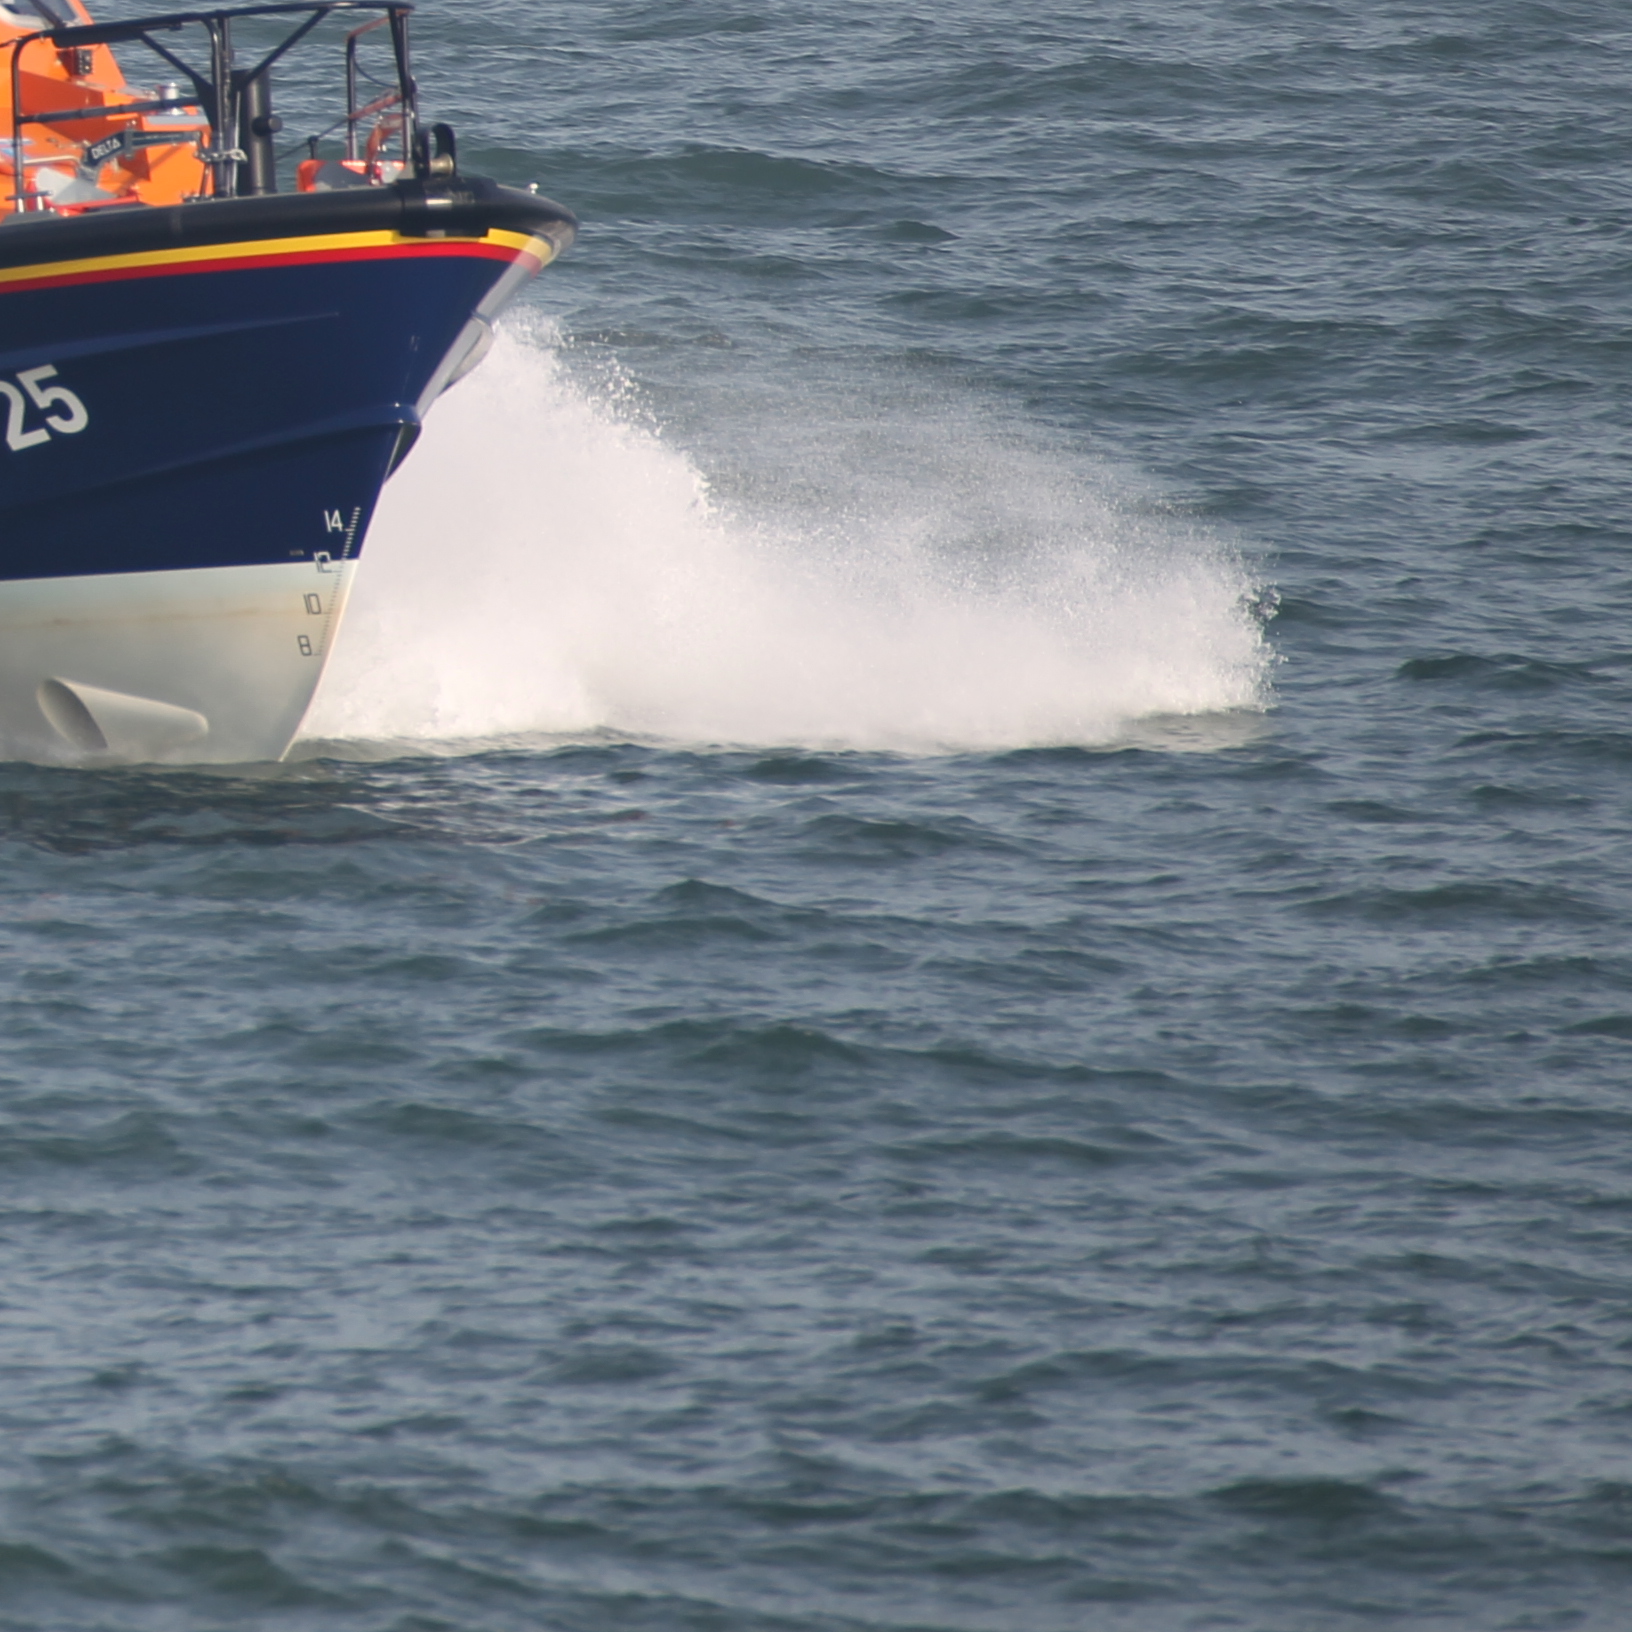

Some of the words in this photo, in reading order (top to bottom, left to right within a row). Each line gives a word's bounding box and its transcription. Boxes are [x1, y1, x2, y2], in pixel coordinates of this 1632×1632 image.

[91, 138, 122, 159] DELTA
[324, 509, 344, 533] 14
[314, 551, 333, 574] 12
[303, 593, 322, 615] 10
[297, 635, 313, 657] 8
